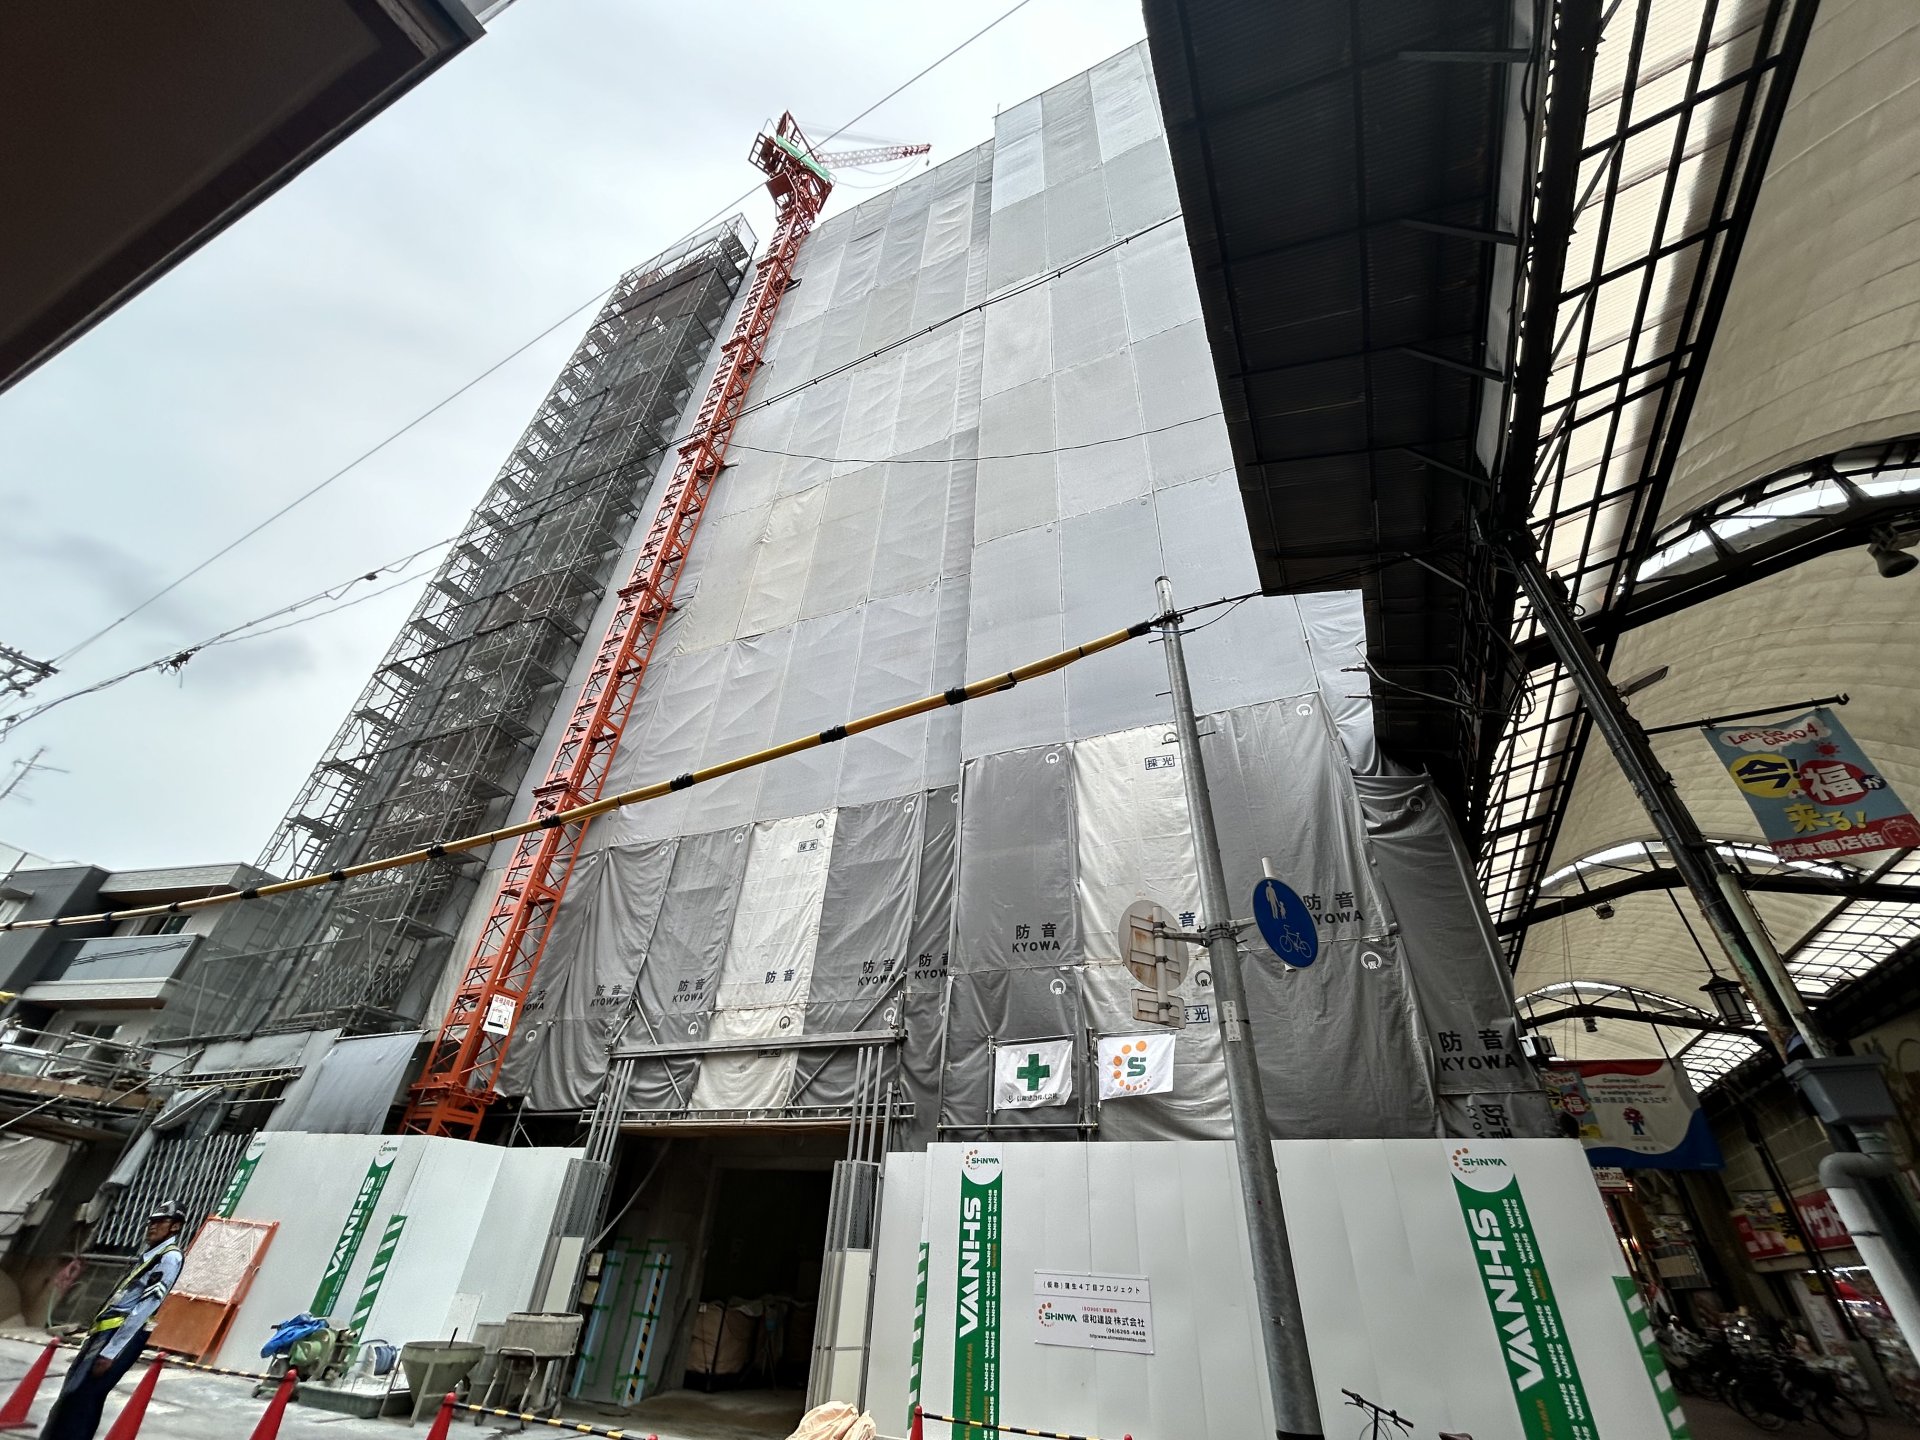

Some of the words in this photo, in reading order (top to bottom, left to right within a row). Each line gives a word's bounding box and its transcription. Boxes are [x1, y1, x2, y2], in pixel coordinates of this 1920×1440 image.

[1775, 831, 1887, 860] 城東商店街
[1313, 910, 1364, 925] YOWA
[1016, 922, 1056, 940] 防音
[1012, 940, 1060, 952] KYOWA
[862, 958, 896, 974] 防音
[765, 969, 795, 984] 防音
[858, 975, 896, 986] KYOWA
[914, 968, 948, 980] KYOW
[678, 978, 706, 992] 防音
[590, 998, 620, 1008] KYOWA
[672, 992, 704, 1003] KYOWA
[1439, 1028, 1504, 1053] 防音
[1440, 1054, 1519, 1072] KYOWA
